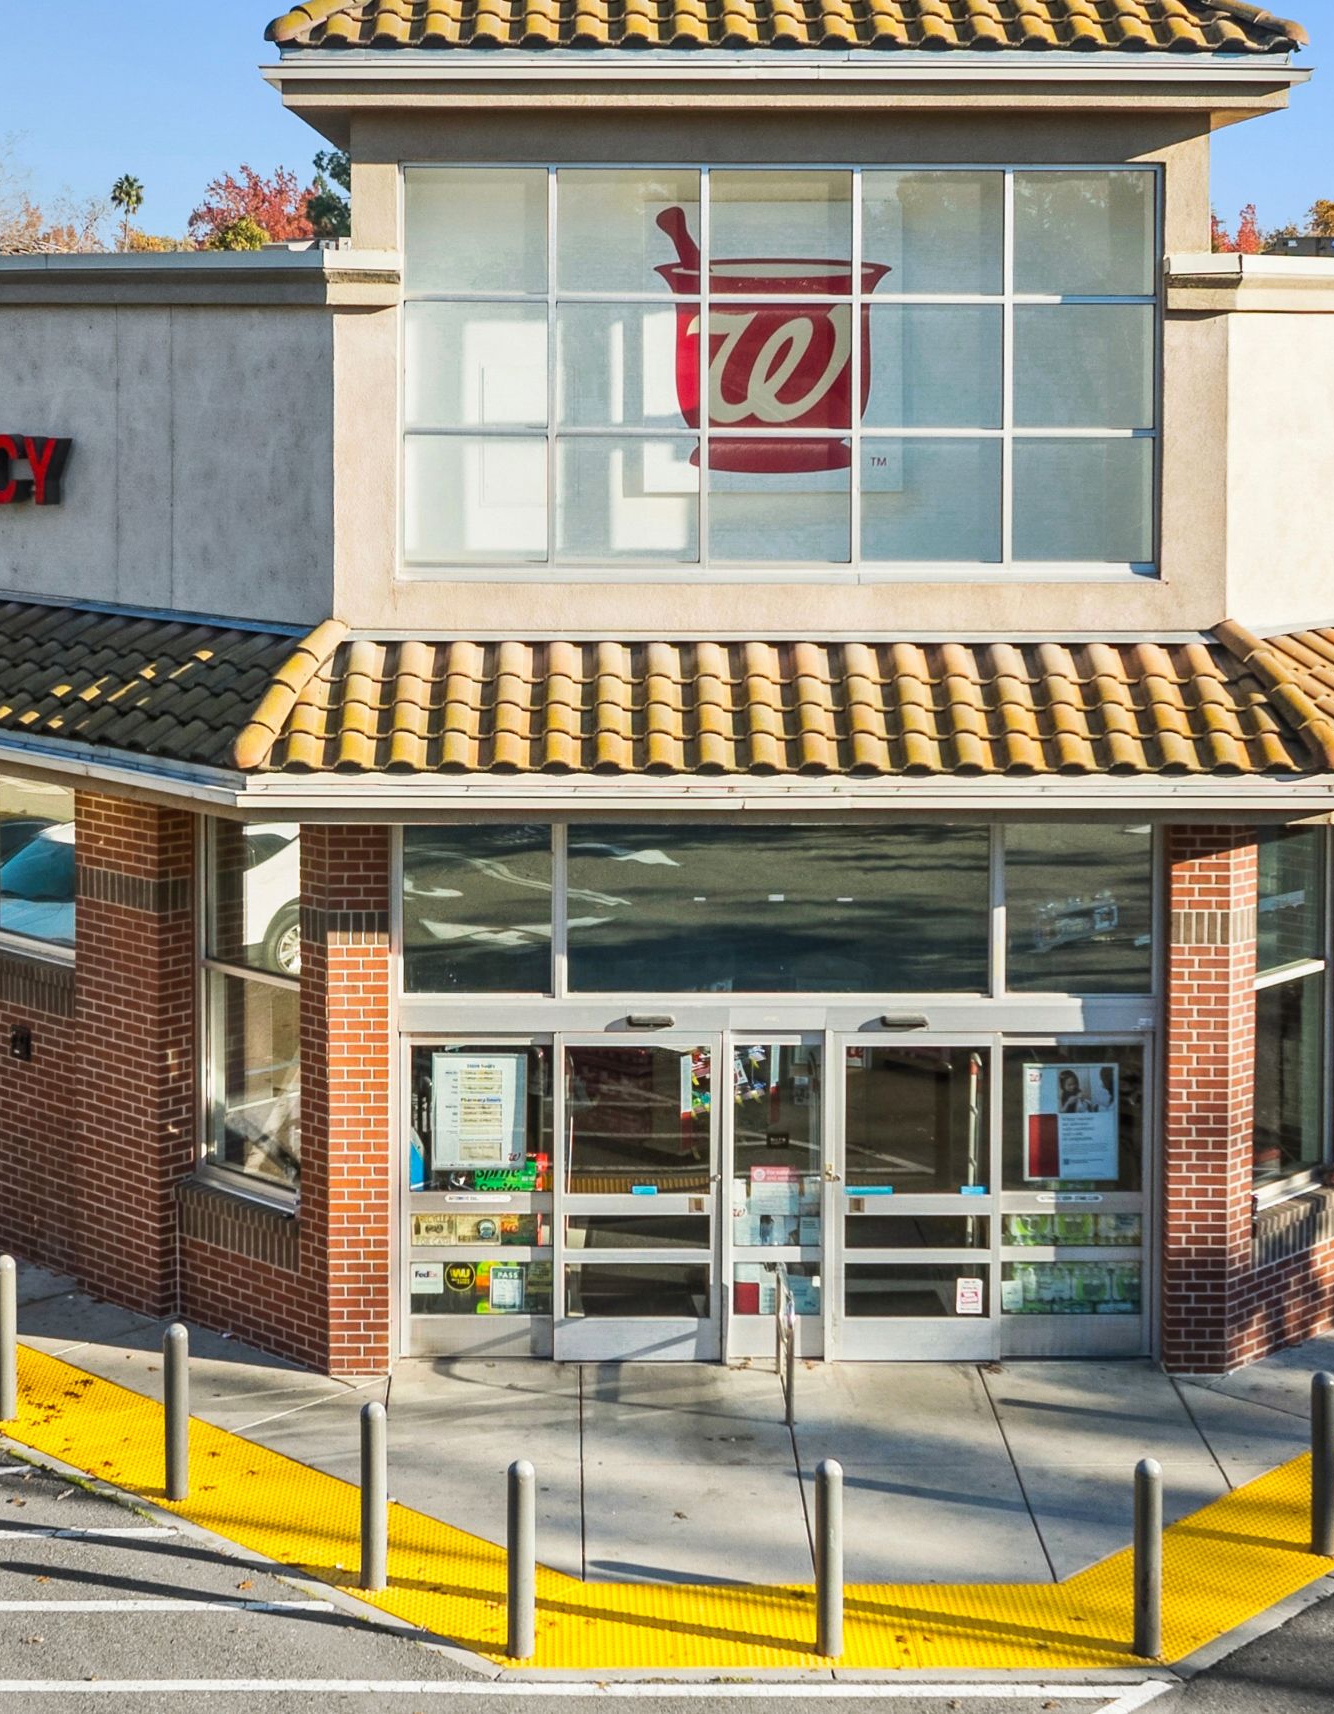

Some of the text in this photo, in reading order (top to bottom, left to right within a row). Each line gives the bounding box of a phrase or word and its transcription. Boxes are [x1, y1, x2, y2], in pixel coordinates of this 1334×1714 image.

[870, 457, 888, 467] TM
[414, 1270, 438, 1279] FedEx
[497, 1271, 519, 1279] PASS
